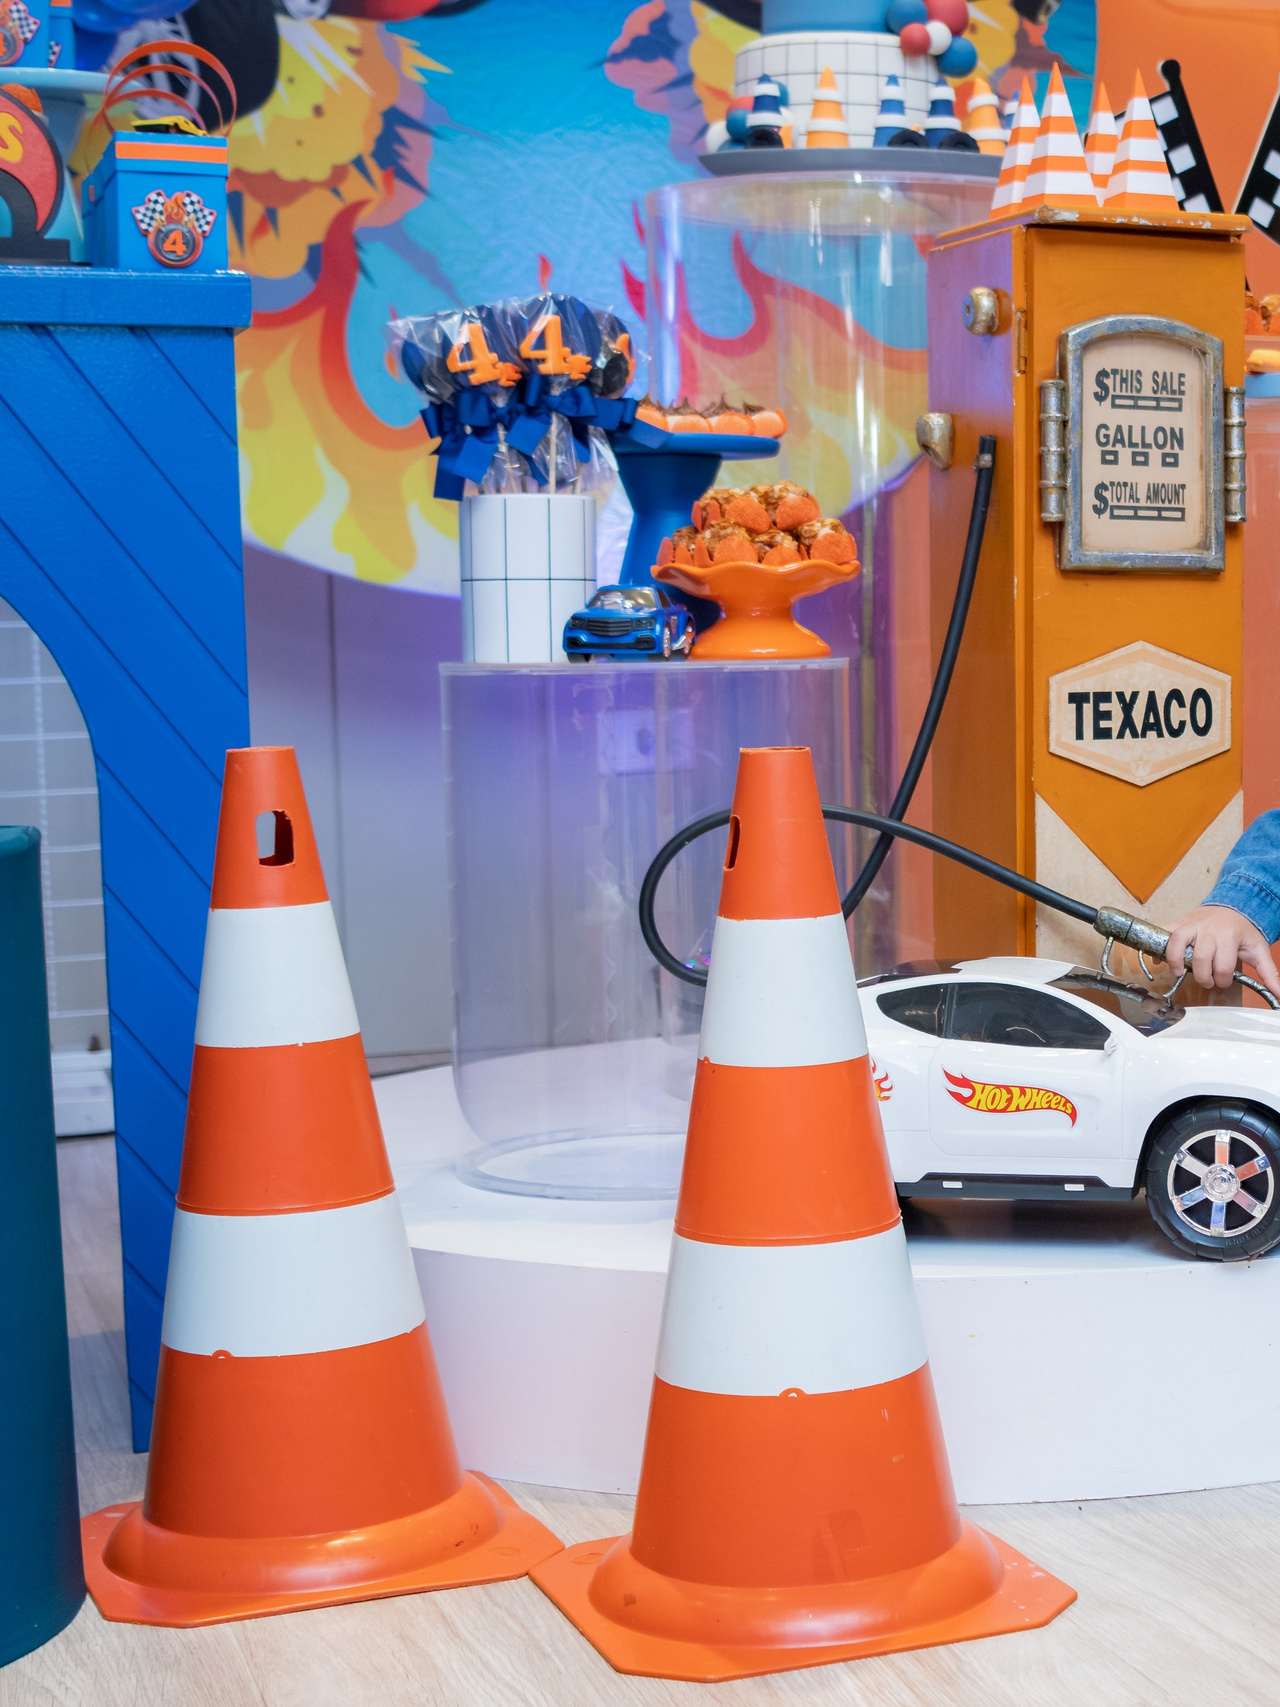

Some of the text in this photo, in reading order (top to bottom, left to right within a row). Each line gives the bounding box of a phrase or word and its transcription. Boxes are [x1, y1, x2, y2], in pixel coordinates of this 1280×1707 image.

[163, 230, 186, 256] 4
[447, 323, 499, 386] 4
[520, 314, 571, 375] 4
[1152, 370, 1186, 396] SALE
[1095, 423, 1184, 451] GALLON
[1146, 482, 1186, 506] AMOUNT
[1068, 687, 1213, 741] TEXACO
